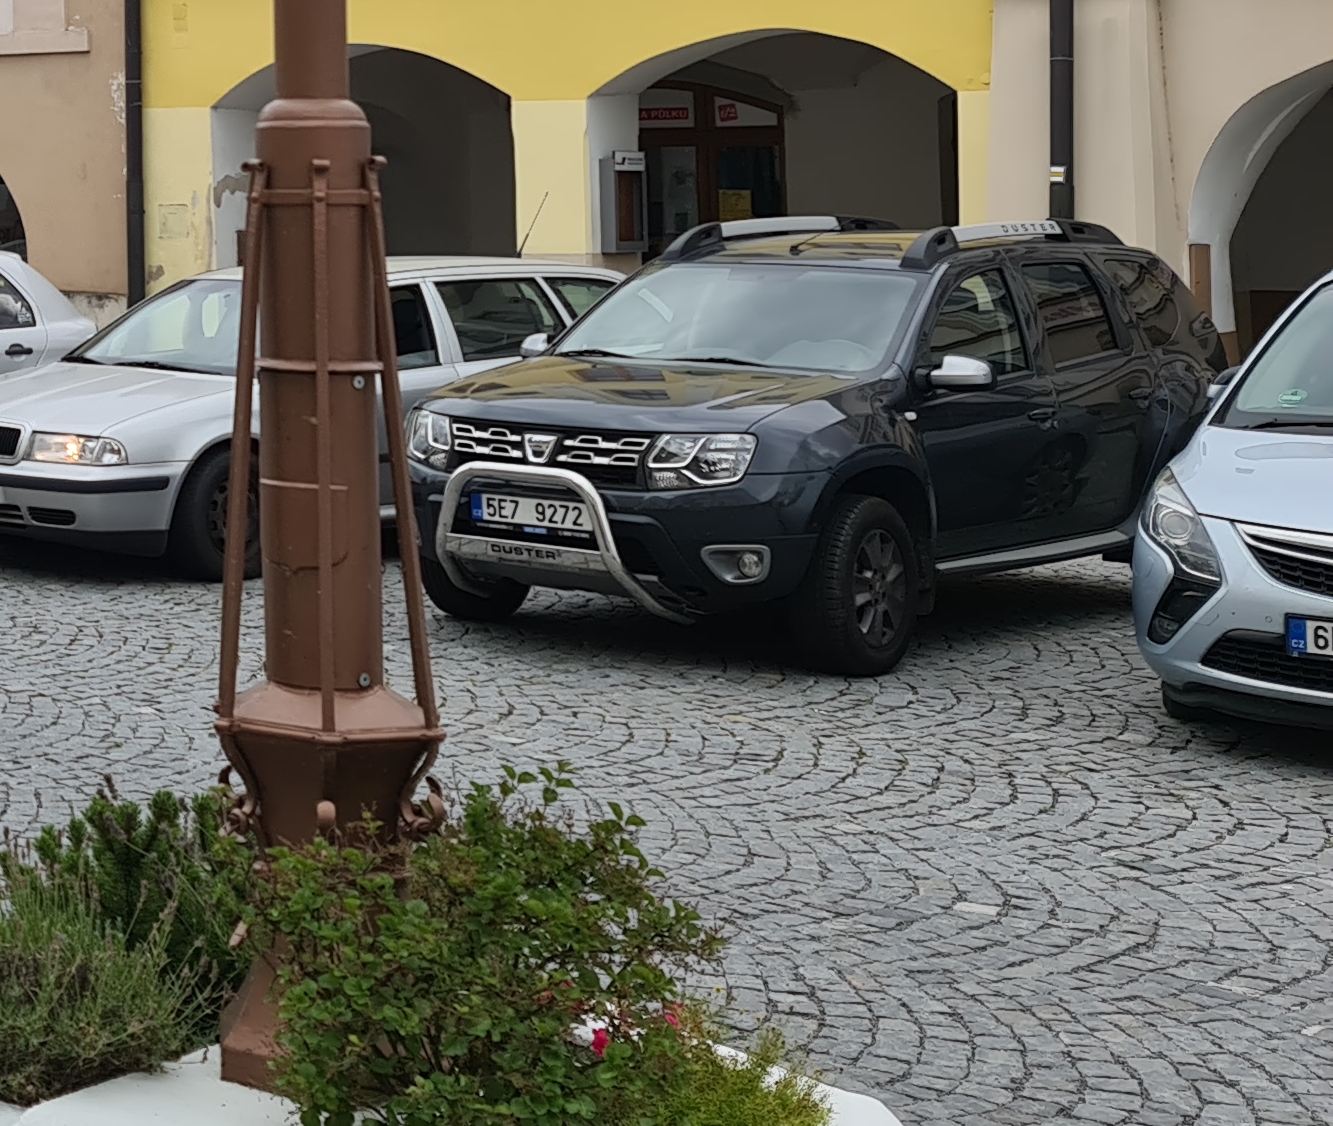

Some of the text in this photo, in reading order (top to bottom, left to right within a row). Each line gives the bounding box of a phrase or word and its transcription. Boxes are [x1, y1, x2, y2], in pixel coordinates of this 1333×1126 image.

[1001, 223, 1057, 233] DUSTER
[486, 497, 584, 527] 5E7 9272
[491, 544, 556, 560] DUSTER
[1291, 639, 1305, 648] CZ
[1314, 625, 1333, 651] 6
